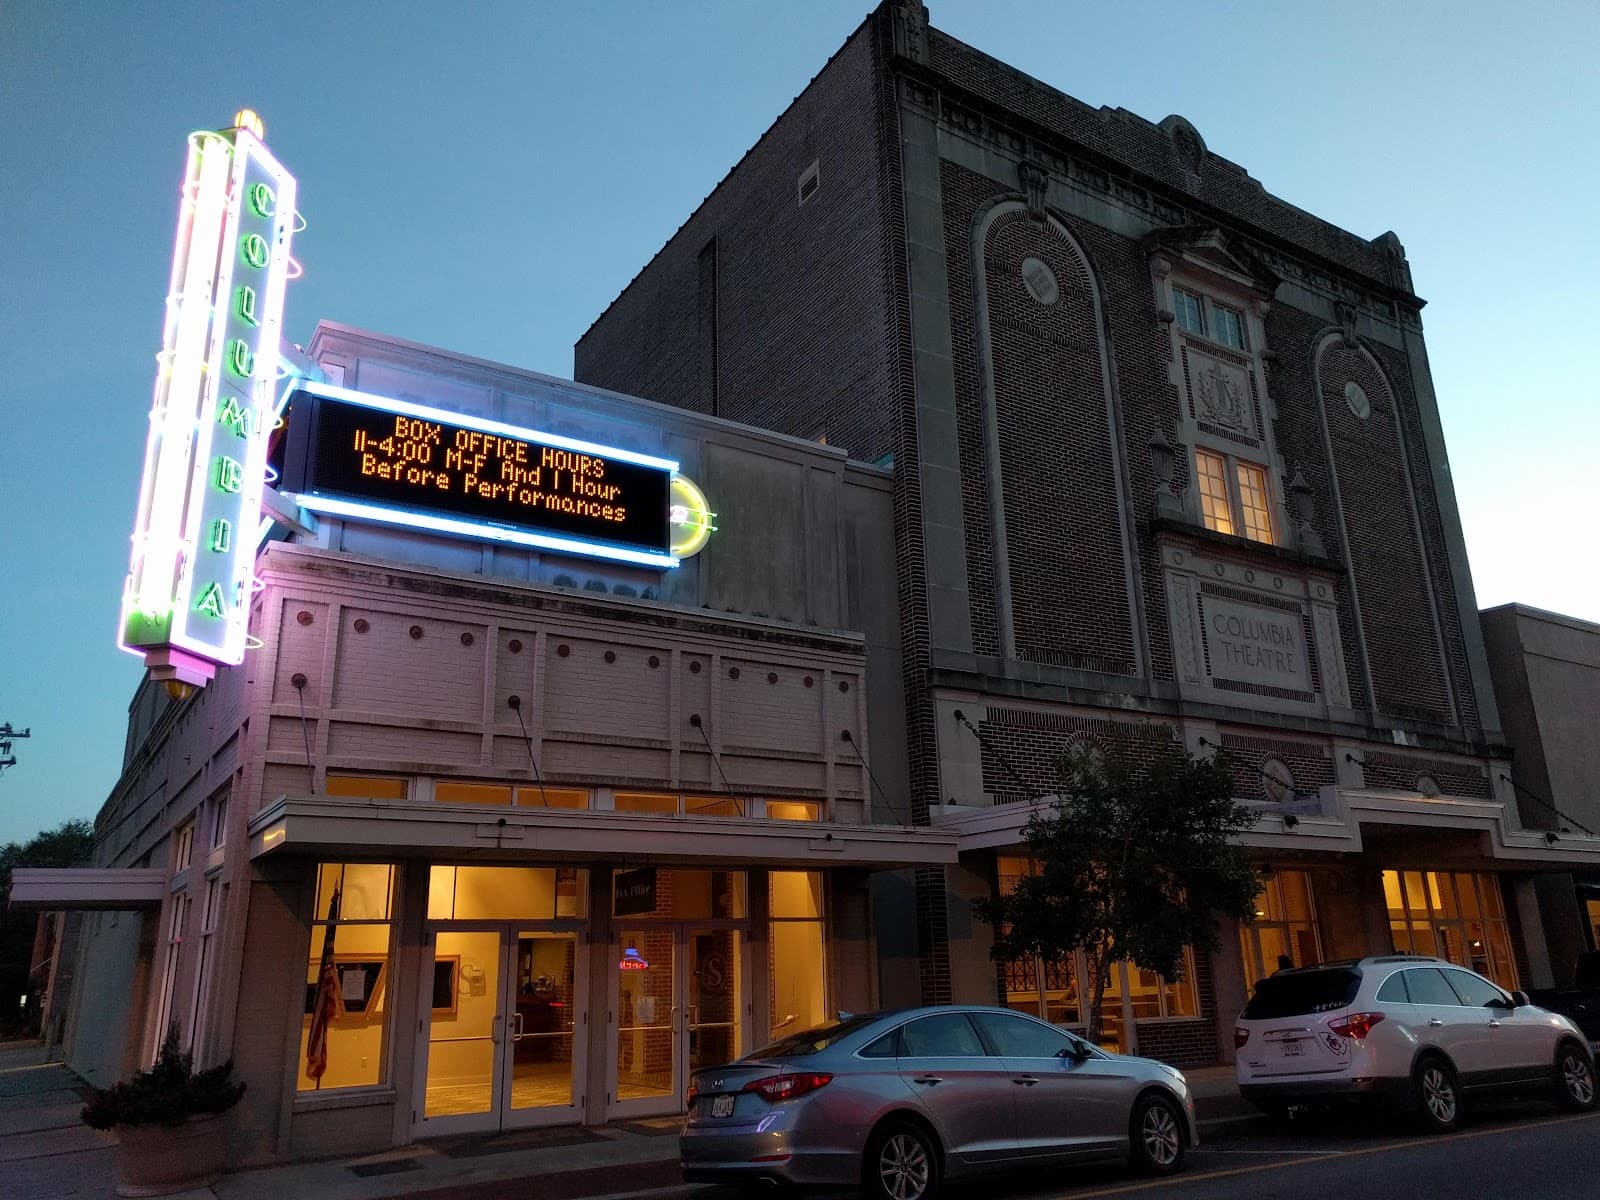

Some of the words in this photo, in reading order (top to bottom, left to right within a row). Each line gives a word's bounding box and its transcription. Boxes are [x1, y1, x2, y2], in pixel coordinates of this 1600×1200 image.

[195, 182, 278, 620] COLUMBIA
[354, 429, 431, 464] 11-4:00
[445, 447, 487, 474] M-F
[501, 459, 541, 486] And
[572, 473, 621, 501] Hour
[395, 416, 441, 445] BOX
[455, 429, 528, 463] OFFICE
[541, 446, 605, 479] HOURS
[361, 453, 449, 490] Before
[464, 472, 626, 522] Performances
[1212, 613, 1296, 647] COLUMBIA
[1220, 640, 1298, 674] THEATRE
